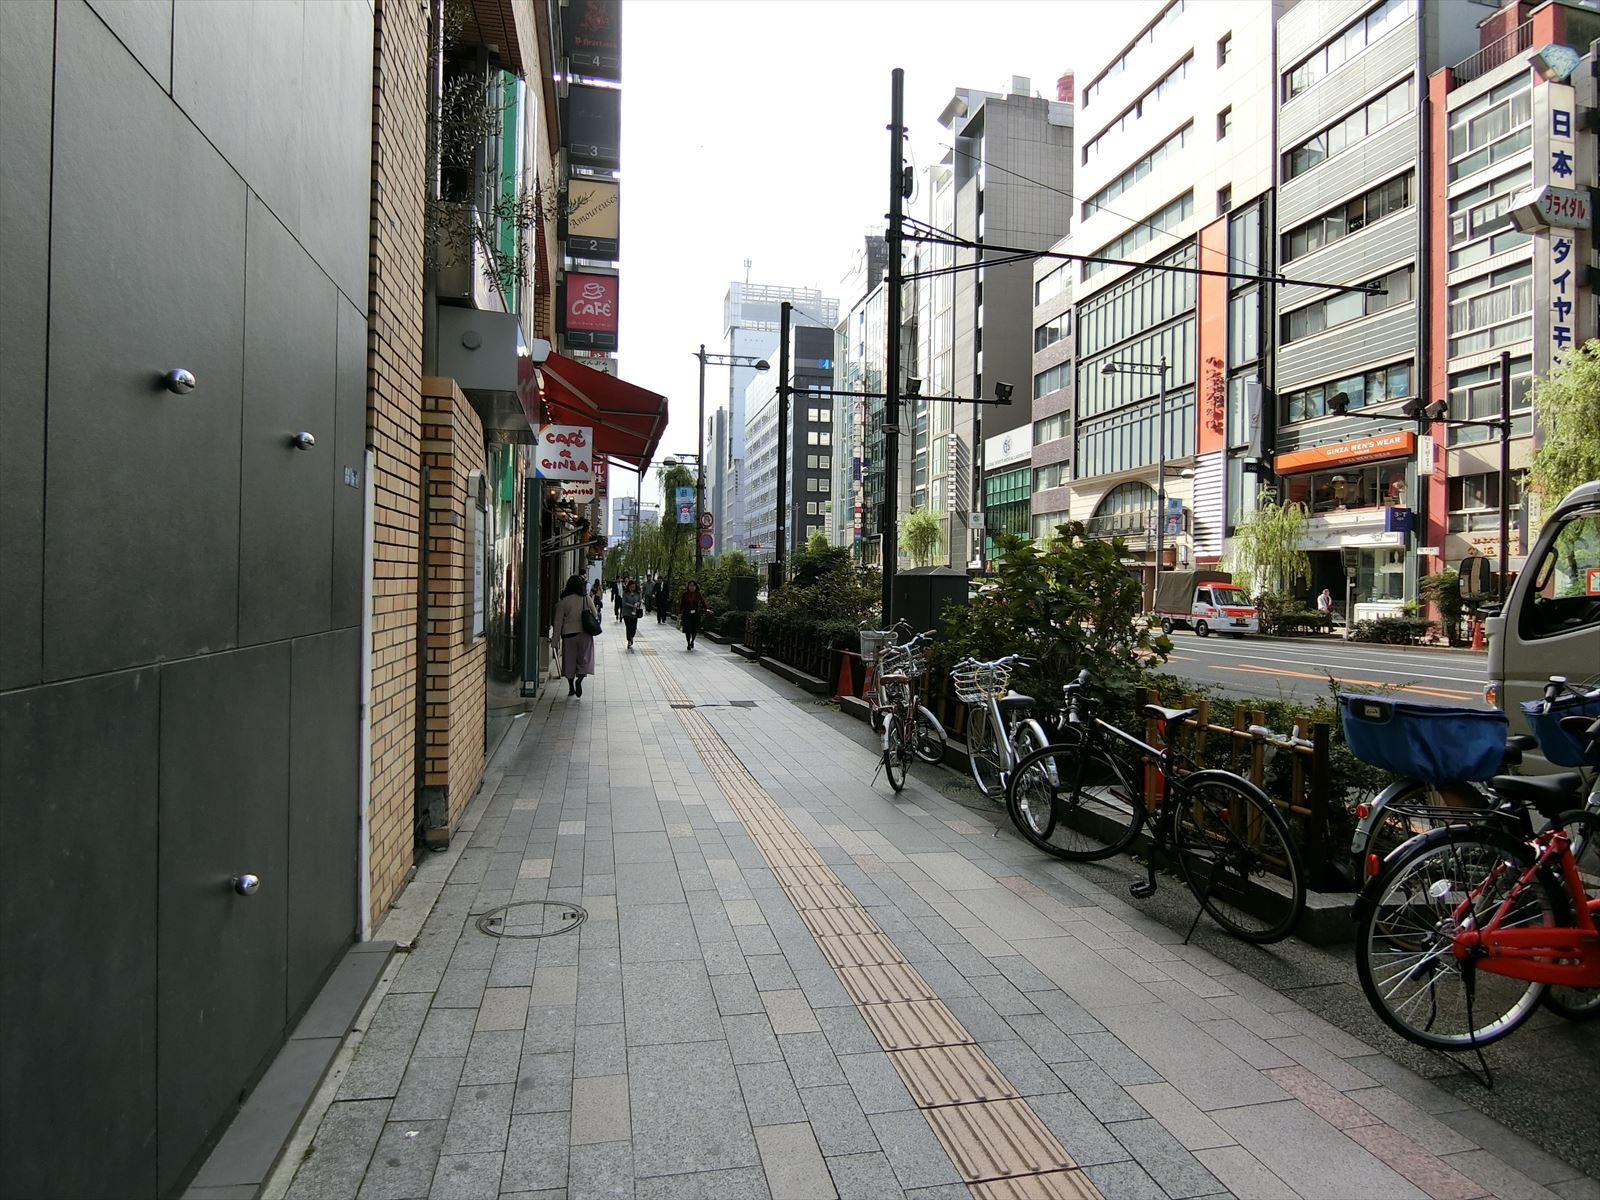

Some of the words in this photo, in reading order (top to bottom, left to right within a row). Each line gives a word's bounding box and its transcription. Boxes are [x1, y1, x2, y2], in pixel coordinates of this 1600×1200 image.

[592, 55, 600, 67] 4
[1552, 109, 1573, 179] 日本
[589, 145, 598, 157] 3
[569, 194, 618, 229] Amoureuses
[589, 239, 598, 251] 2
[588, 332, 594, 343] 1
[1326, 446, 1349, 456] GINZA
[1350, 441, 1375, 451] MEN'S
[1376, 436, 1401, 447] WEAR
[559, 449, 571, 458] de
[541, 458, 589, 473] GINZA
